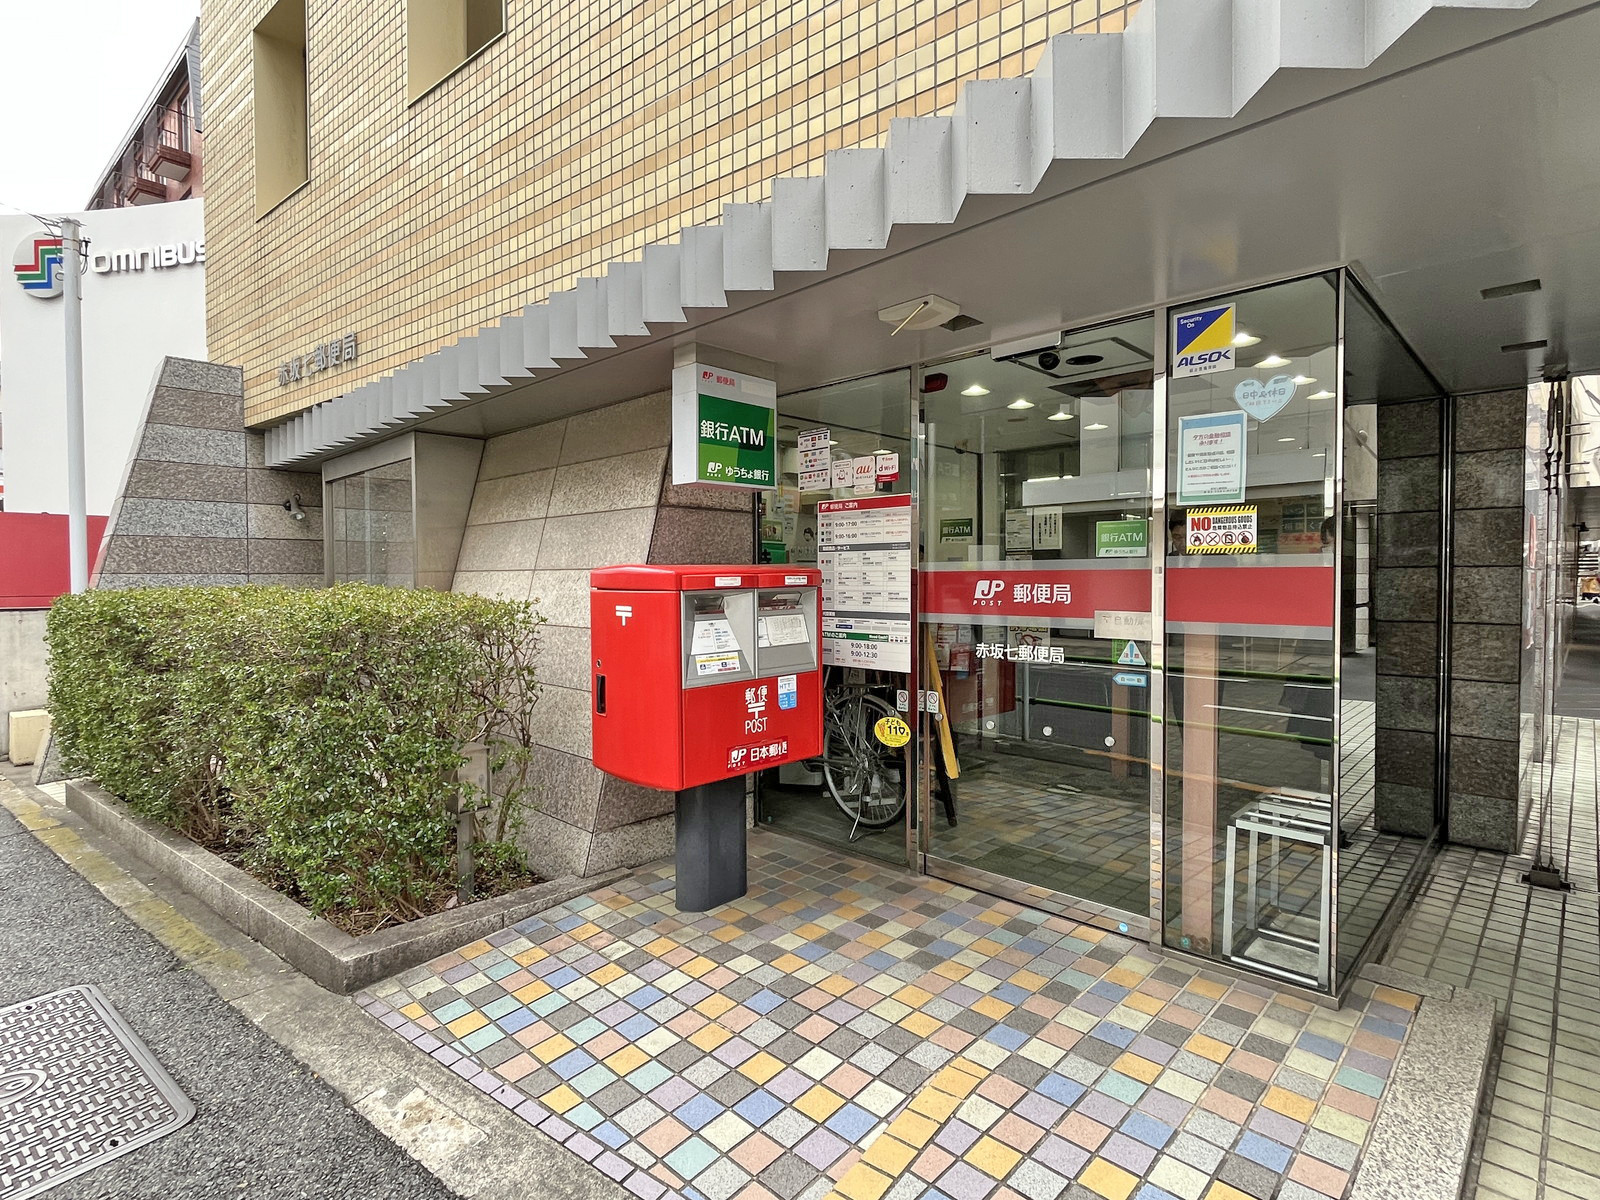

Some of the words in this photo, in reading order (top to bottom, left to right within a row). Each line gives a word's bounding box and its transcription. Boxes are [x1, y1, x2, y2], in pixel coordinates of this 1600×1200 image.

[1180, 316, 1203, 324] Security
[278, 331, 358, 386] 赤坂七郵便局
[1177, 350, 1231, 368] ALSOK
[700, 420, 764, 446] 銀行ATM
[725, 466, 770, 481] ゆうちょ銀行
[856, 465, 873, 474] au
[1191, 517, 1212, 531] NO
[1212, 517, 1237, 525] DANGEROUS
[1237, 515, 1253, 523] GOODS
[1101, 532, 1143, 543] 銀行ATM
[974, 580, 1005, 599] JP
[1013, 583, 1072, 605] 郵便局
[975, 642, 1065, 664] 赤坂七郵便局
[745, 685, 768, 705] 郵便
[745, 717, 768, 735] POST
[731, 748, 747, 763] JP
[750, 741, 788, 762] 日本郵便
